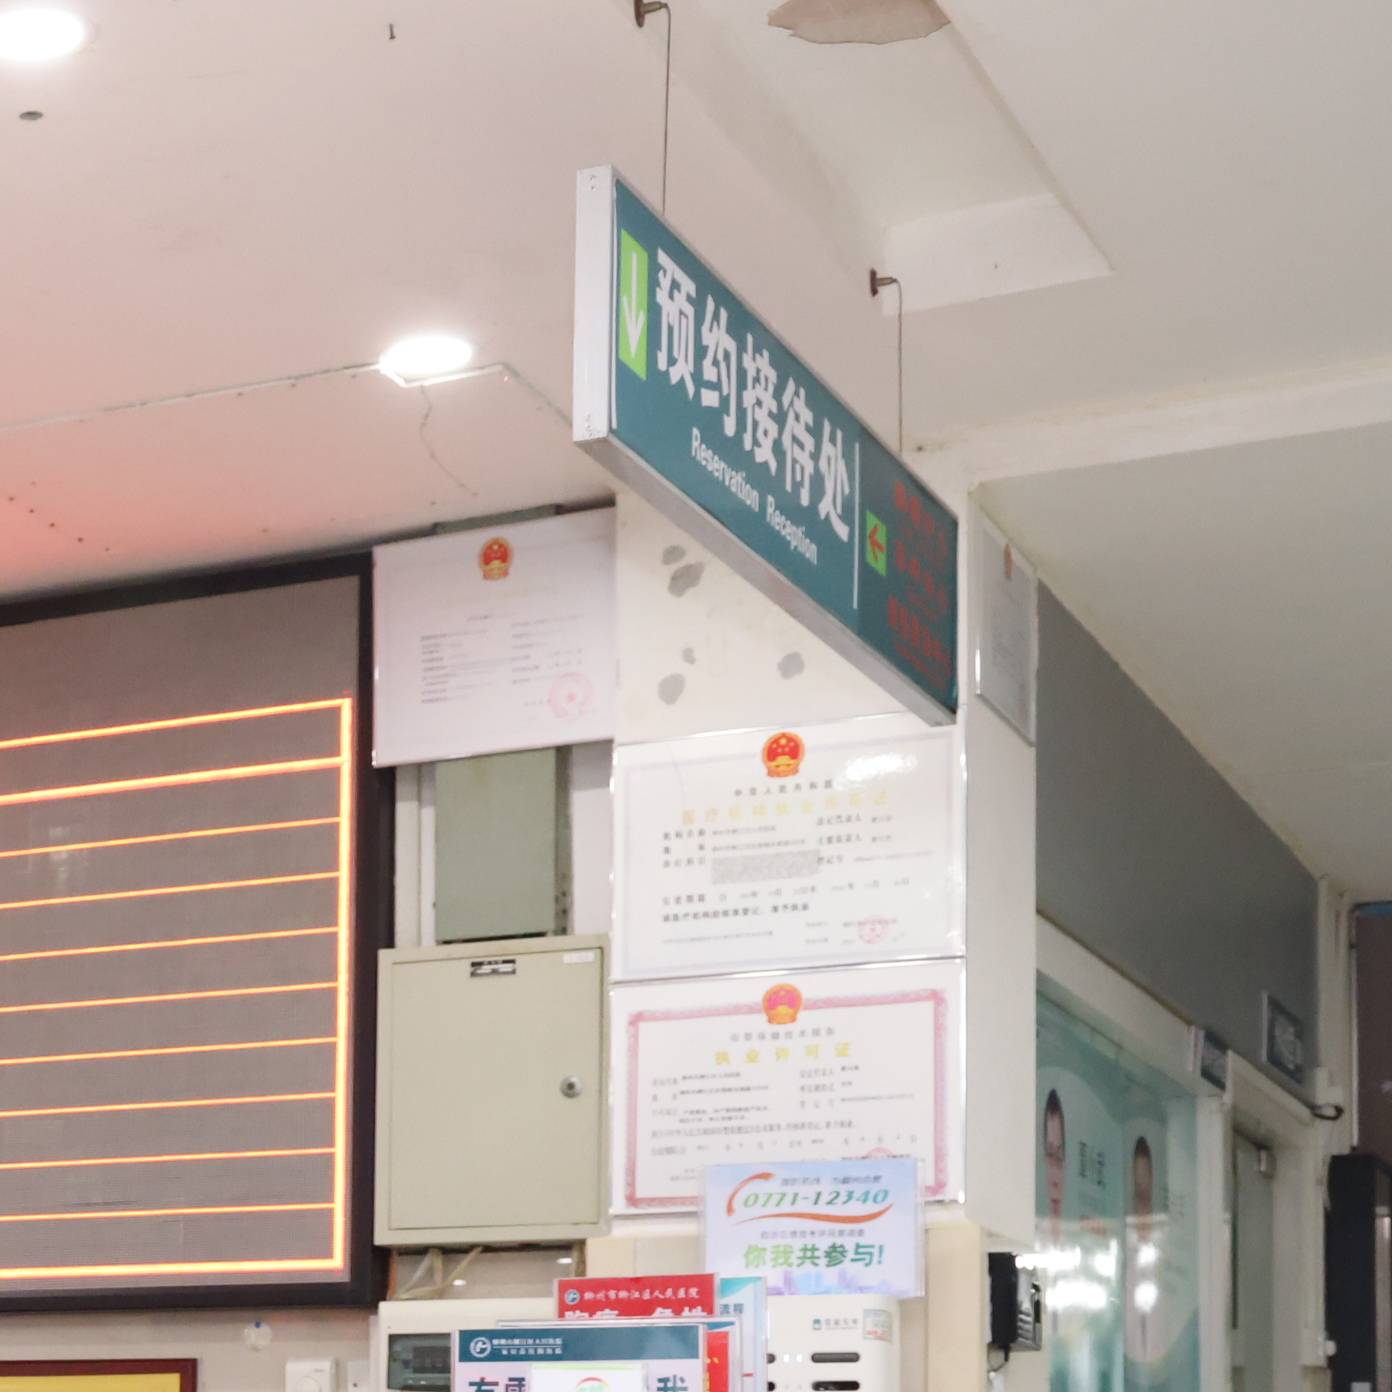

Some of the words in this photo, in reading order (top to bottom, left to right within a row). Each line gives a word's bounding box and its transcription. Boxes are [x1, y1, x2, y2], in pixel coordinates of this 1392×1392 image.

[657, 247, 851, 543] 预约接待处
[691, 427, 760, 513] Reservation
[766, 494, 818, 566] Reception
[743, 1188, 890, 1209] 0771-12340
